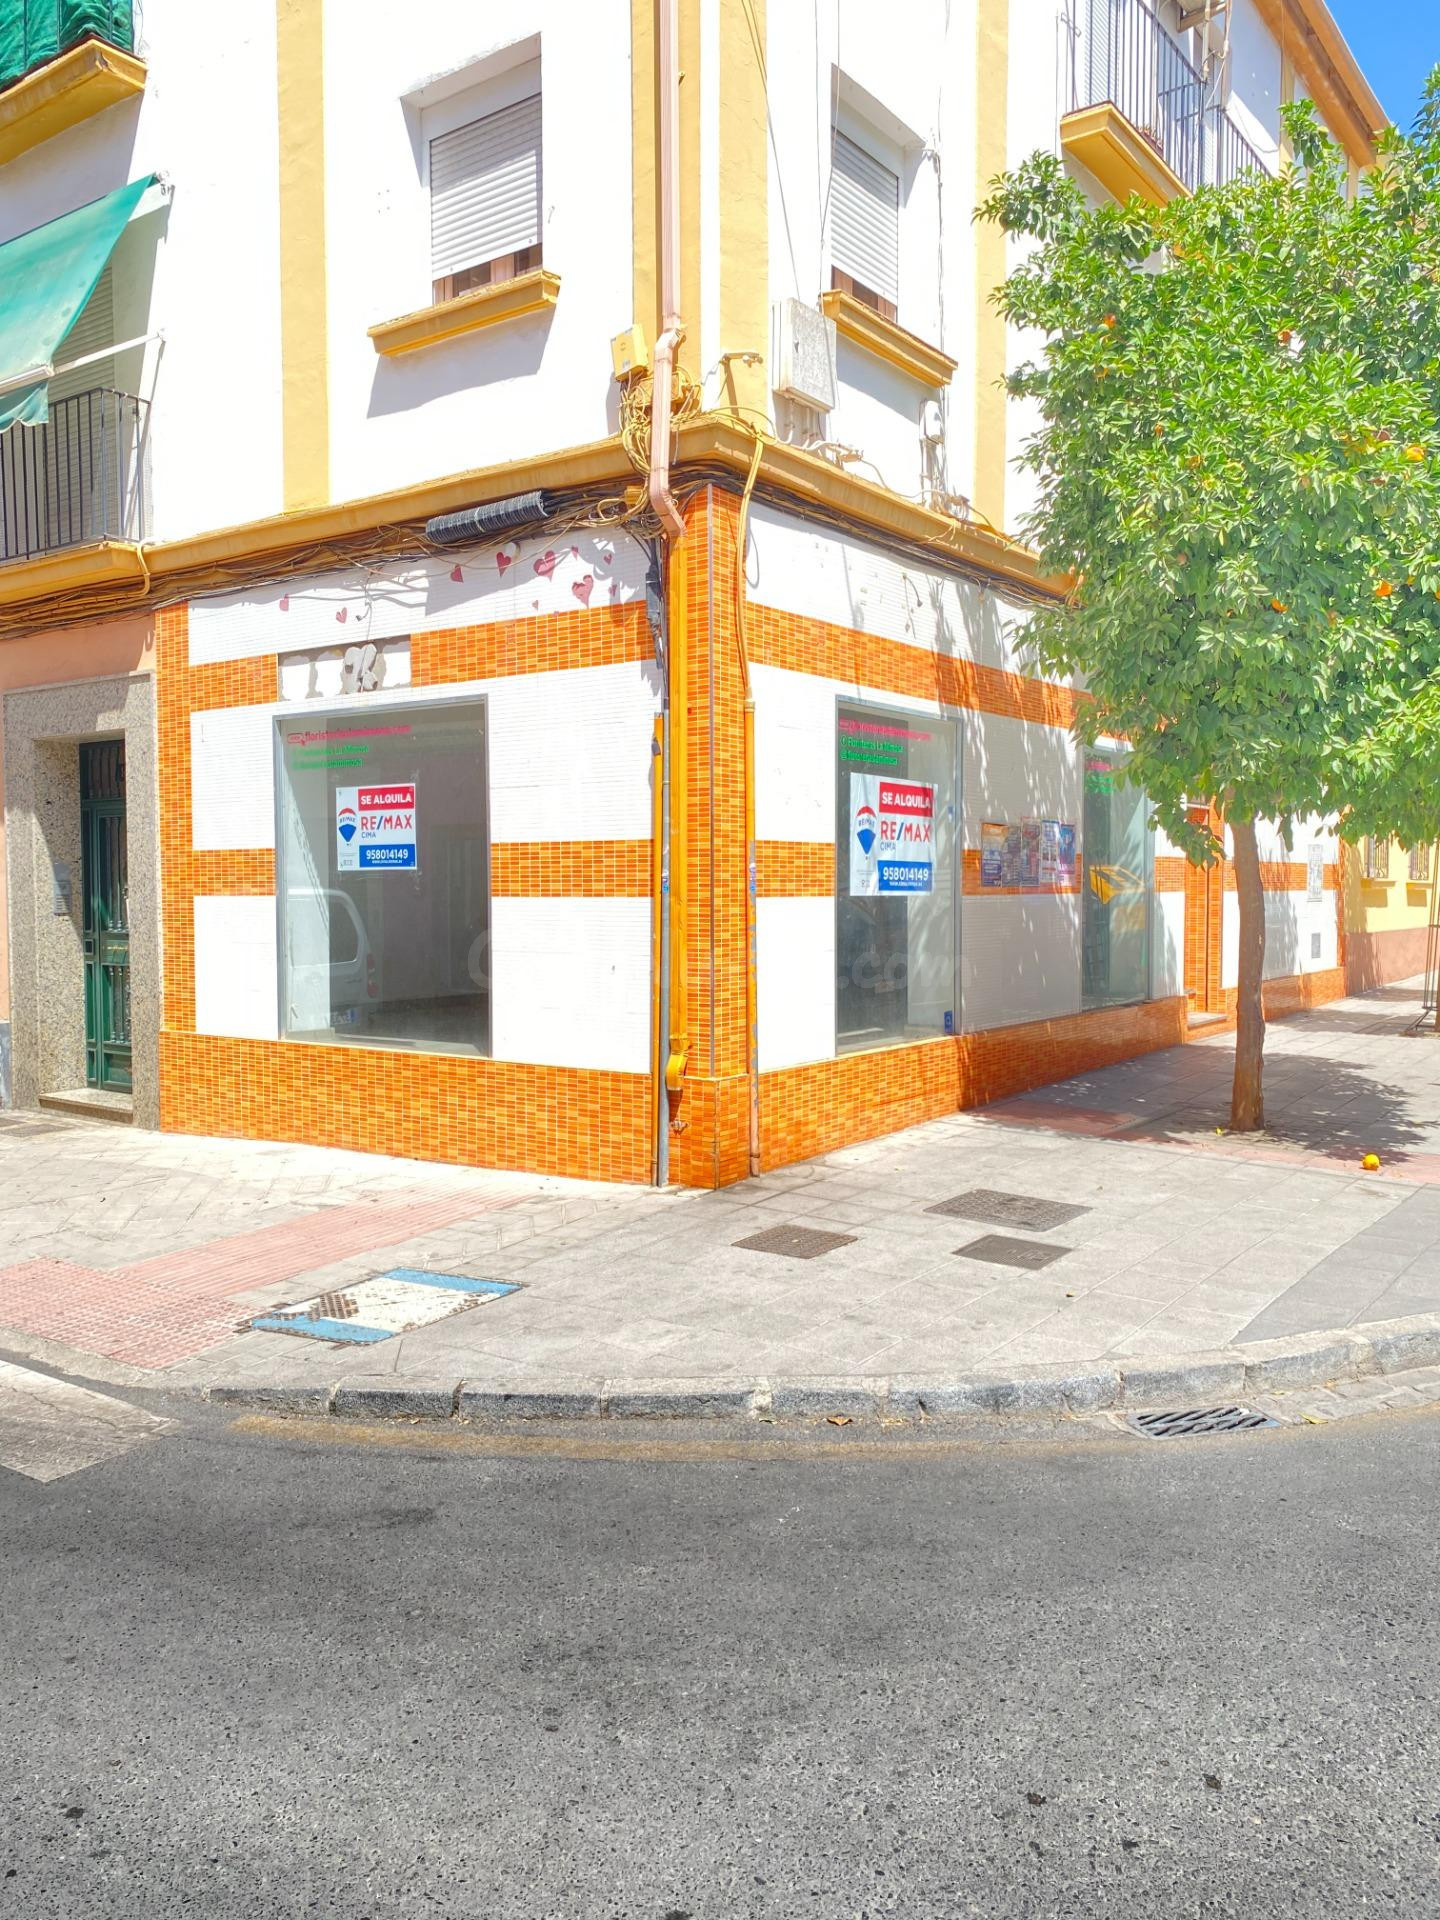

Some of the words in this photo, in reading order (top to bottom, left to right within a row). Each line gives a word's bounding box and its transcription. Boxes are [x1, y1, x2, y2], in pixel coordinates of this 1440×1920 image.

[360, 795, 372, 805] SE
[374, 793, 412, 805] ALQUILA
[882, 791, 893, 805] SE
[894, 794, 930, 809] ALQUILA
[360, 815, 412, 830] RE/MAX
[880, 820, 931, 843] RE/MAX
[880, 842, 896, 851] CIMA
[366, 849, 408, 860] 958014149
[883, 867, 929, 882] 958014149
